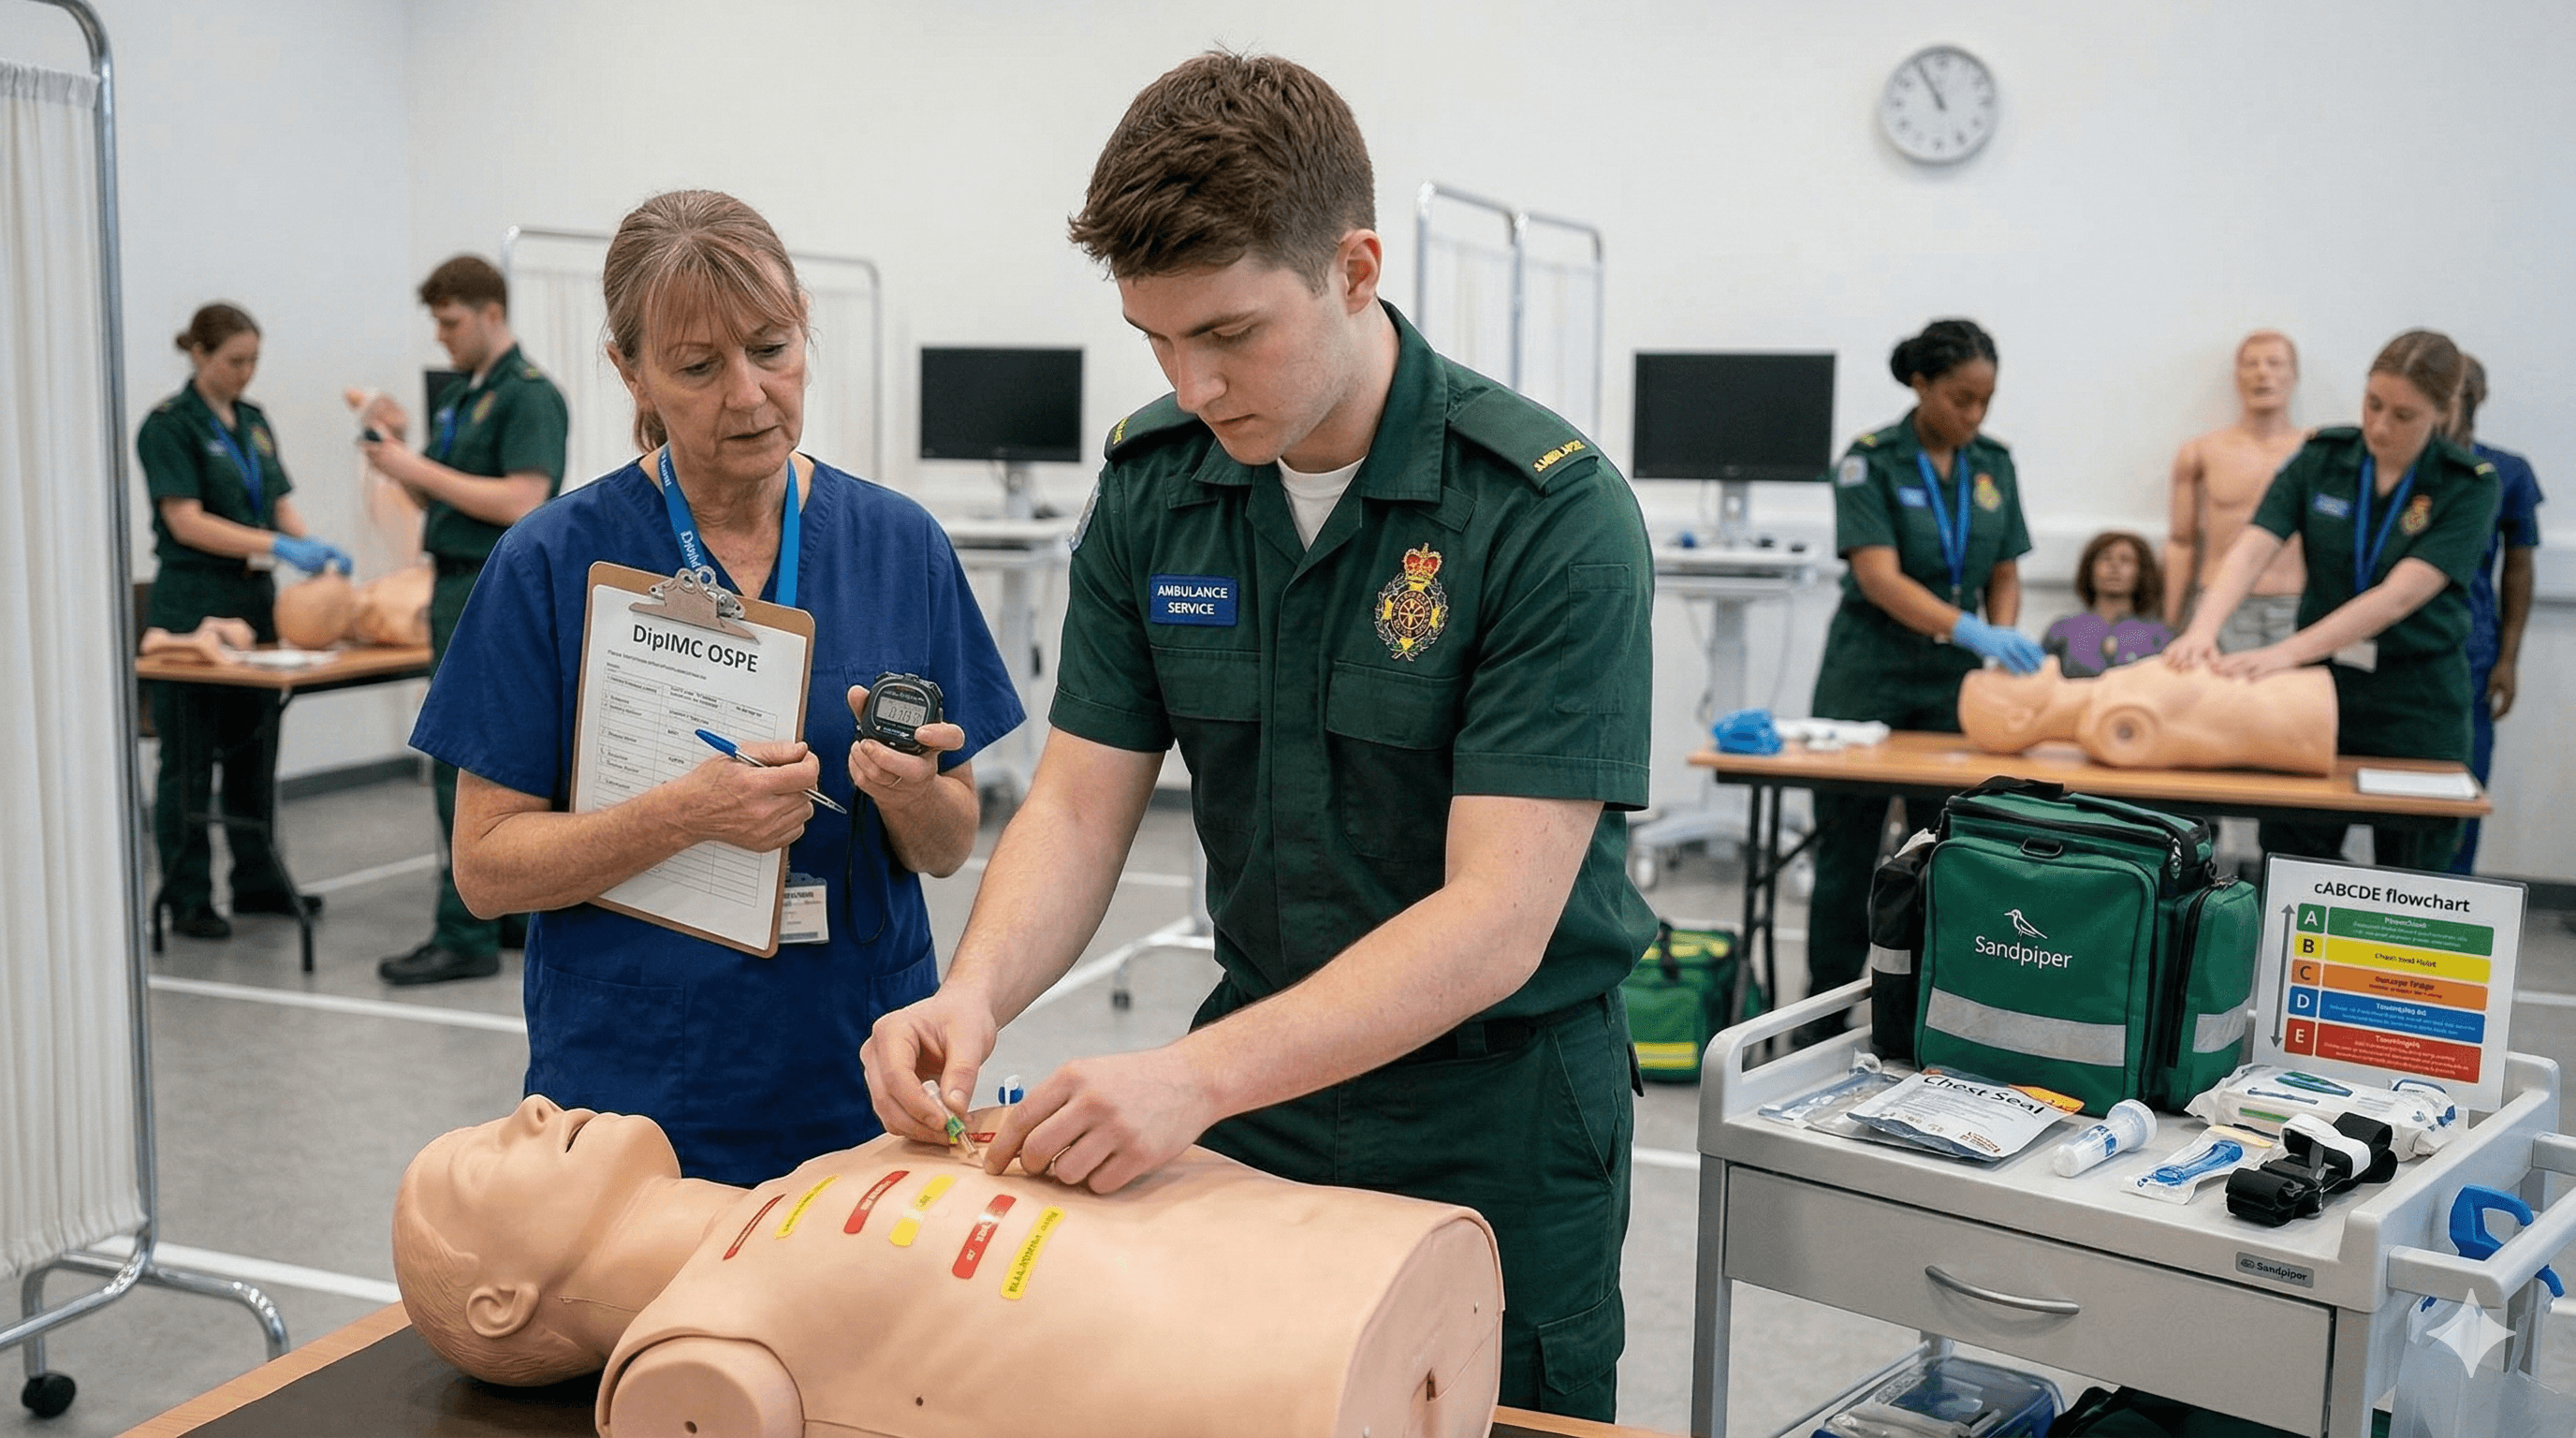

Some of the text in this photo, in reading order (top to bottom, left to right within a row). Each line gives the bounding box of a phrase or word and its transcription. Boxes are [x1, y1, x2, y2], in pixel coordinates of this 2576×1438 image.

[1157, 585, 1228, 599] AMBULANCE
[1167, 601, 1215, 615] SERVICE
[633, 624, 704, 658] DipIMC
[708, 643, 759, 673] OSPE
[2314, 881, 2471, 913] cABCDE flowchart
[2304, 910, 2319, 927] A
[1975, 935, 2073, 969] Sandpiper
[2302, 938, 2315, 954] B
[2299, 965, 2312, 981] C
[2296, 993, 2310, 1009] D
[2294, 1028, 2305, 1044] E
[1924, 1076, 2045, 1115] Chest Seal
